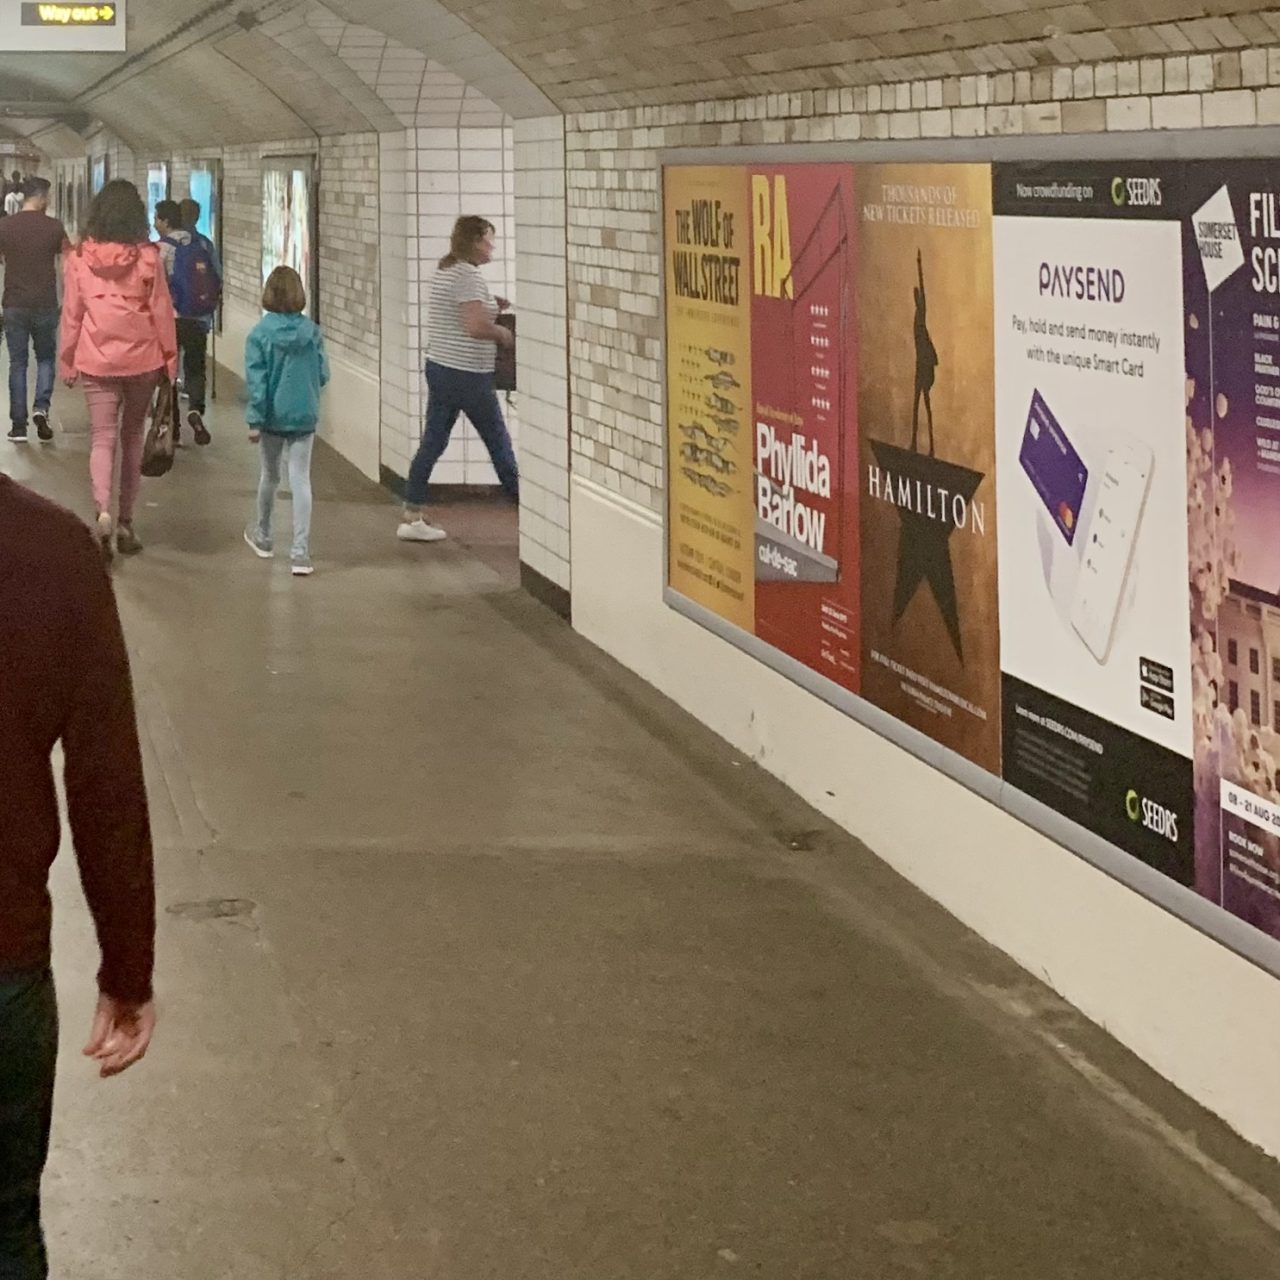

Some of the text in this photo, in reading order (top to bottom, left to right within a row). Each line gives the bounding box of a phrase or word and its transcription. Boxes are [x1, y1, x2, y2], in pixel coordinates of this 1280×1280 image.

[39, 4, 99, 23] Way out
[881, 184, 956, 205] THOUSANDS OF
[1016, 182, 1093, 202] Now crowdfunding on
[1126, 177, 1162, 205] SEEDRS
[675, 199, 734, 249] THE WOLF OF
[863, 203, 980, 228] NEW TICKETS RELEASED
[1198, 221, 1236, 240] SOMERSET
[751, 174, 794, 300] RA
[1199, 241, 1223, 259] HOUSE
[673, 250, 740, 306] WALL STREET
[1039, 262, 1125, 303] PAYSEND
[1251, 246, 1280, 293] SC
[1012, 314, 1160, 353] Pay, hold and send money instantly
[1252, 313, 1272, 329] PAIN
[1026, 344, 1144, 378] with the unique Smart Card
[756, 422, 831, 498] Phyllida
[757, 474, 825, 552] Barlow
[868, 464, 985, 536] HAMILTON
[758, 542, 797, 577] cul-de-sac
[1141, 797, 1178, 842] SEEDRS
[1228, 791, 1238, 806] 08
[1244, 800, 1252, 813] 21
[1254, 805, 1270, 822] AUG
